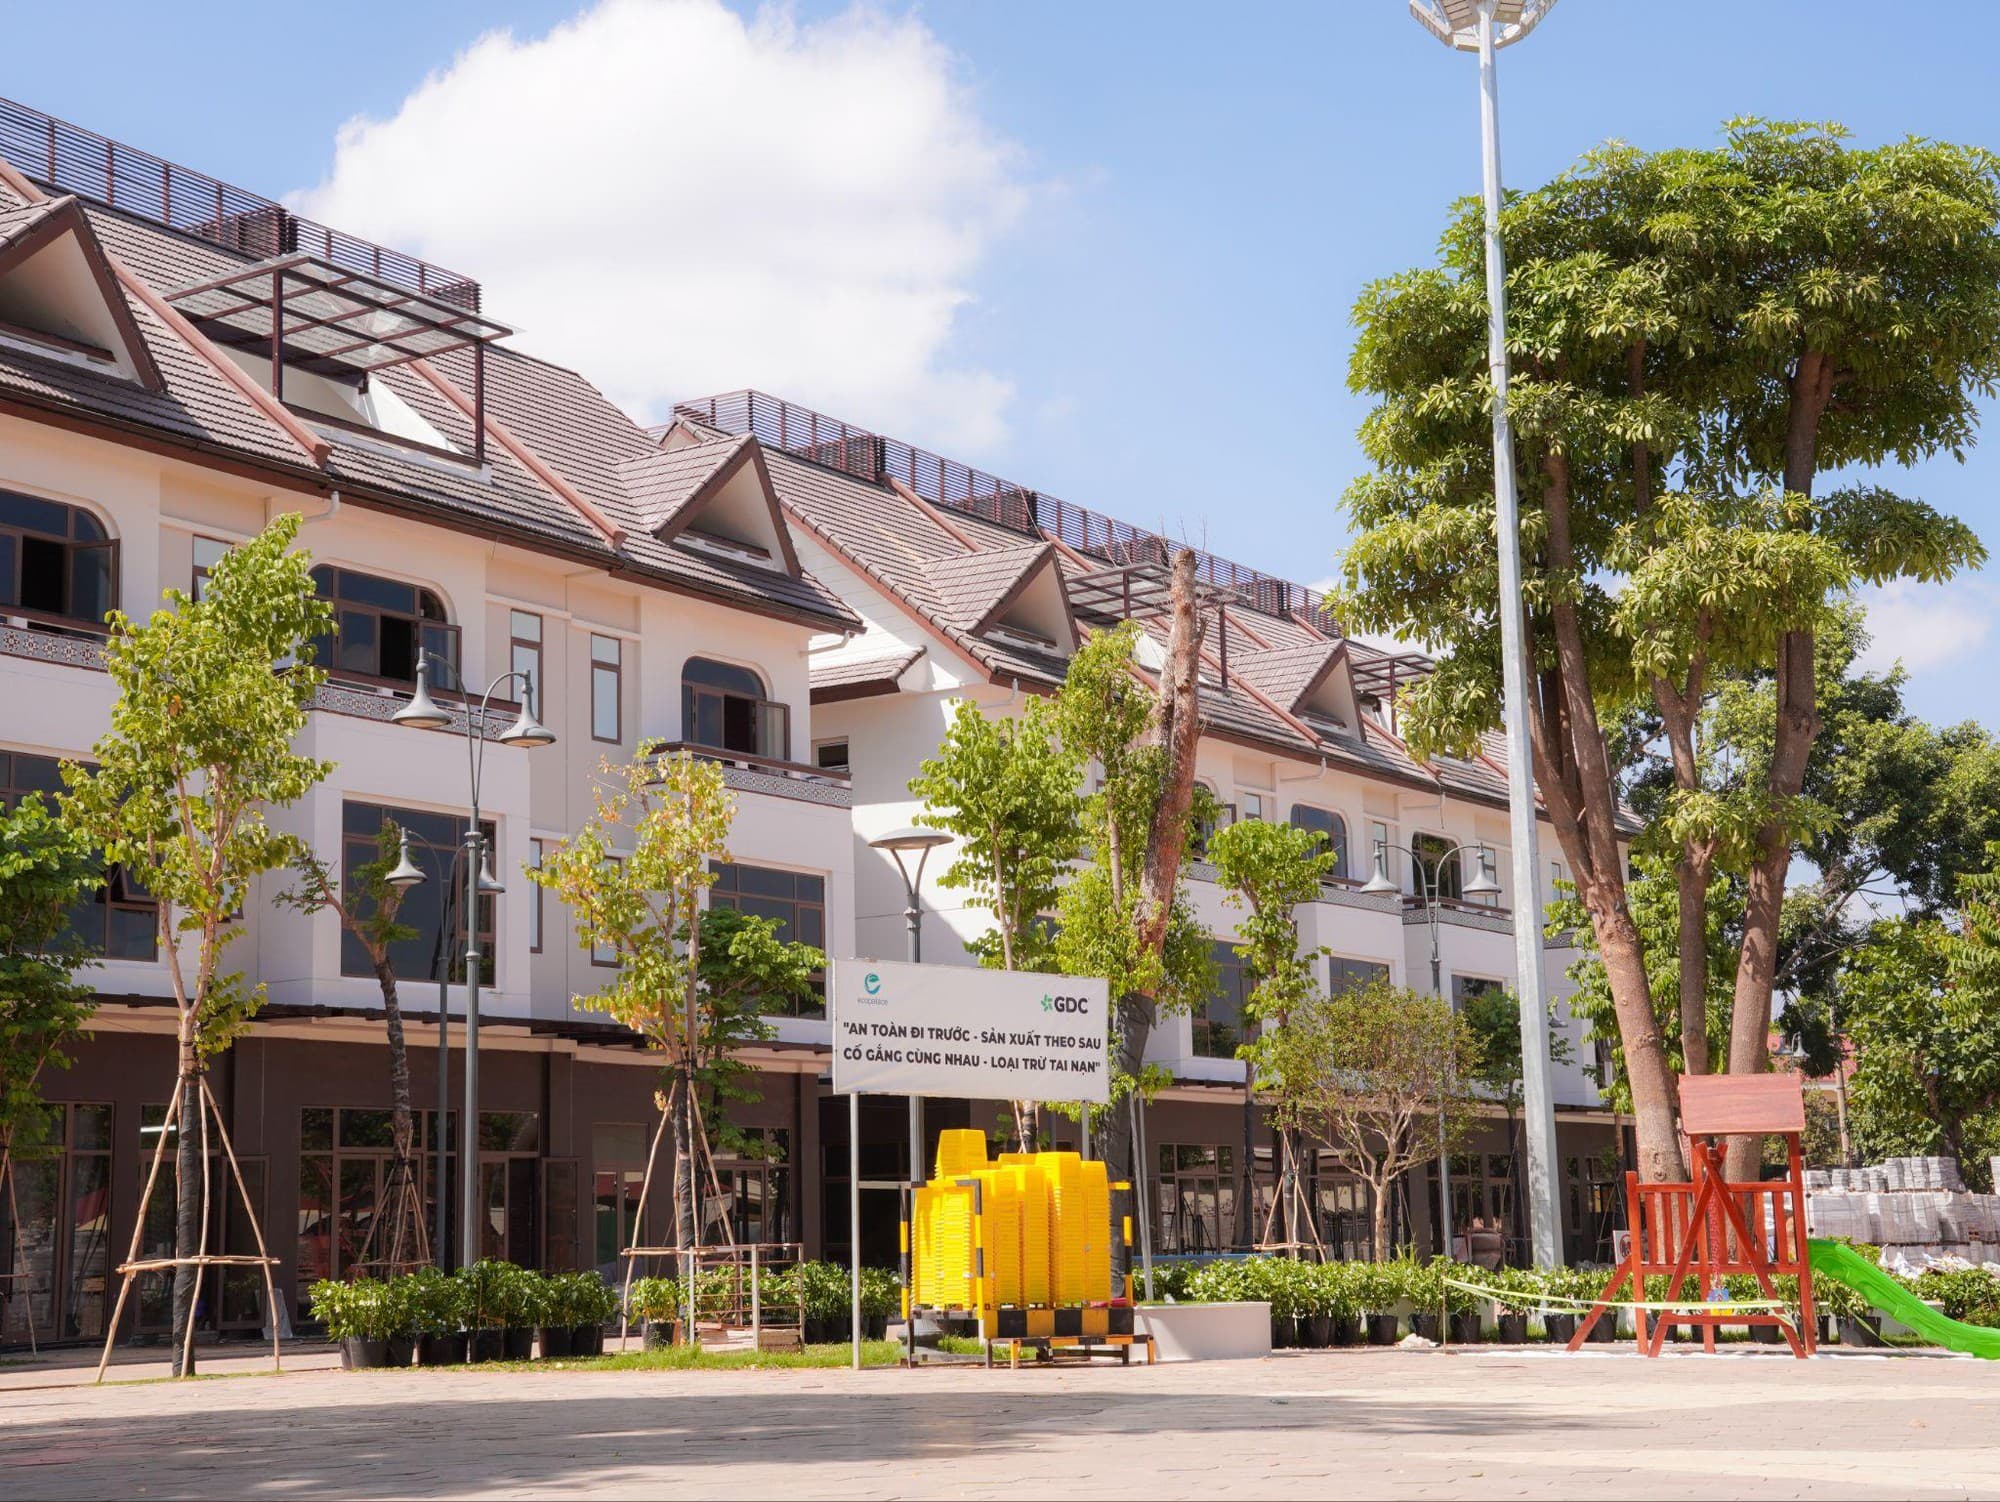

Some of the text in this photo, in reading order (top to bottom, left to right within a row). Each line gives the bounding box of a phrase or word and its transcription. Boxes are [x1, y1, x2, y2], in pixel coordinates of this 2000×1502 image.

[1054, 996, 1088, 1014] GDC
[843, 1022, 867, 1035] "AN
[871, 1021, 907, 1038] TOÀN
[910, 1026, 924, 1039] ĐI
[928, 1025, 970, 1042] TRƯỚC
[1009, 1030, 1041, 1047] XUẤT
[1044, 1035, 1076, 1048] THEO
[1078, 1037, 1101, 1050] SAU
[843, 1043, 862, 1060] CỐ
[906, 1047, 941, 1065] CÙNG
[945, 1053, 980, 1067] NHAU
[991, 1056, 1019, 1073] LOẠI
[1022, 1055, 1047, 1070] TRỪ
[1050, 1059, 1067, 1071] TAI
[1071, 1060, 1101, 1076] NẠN"
